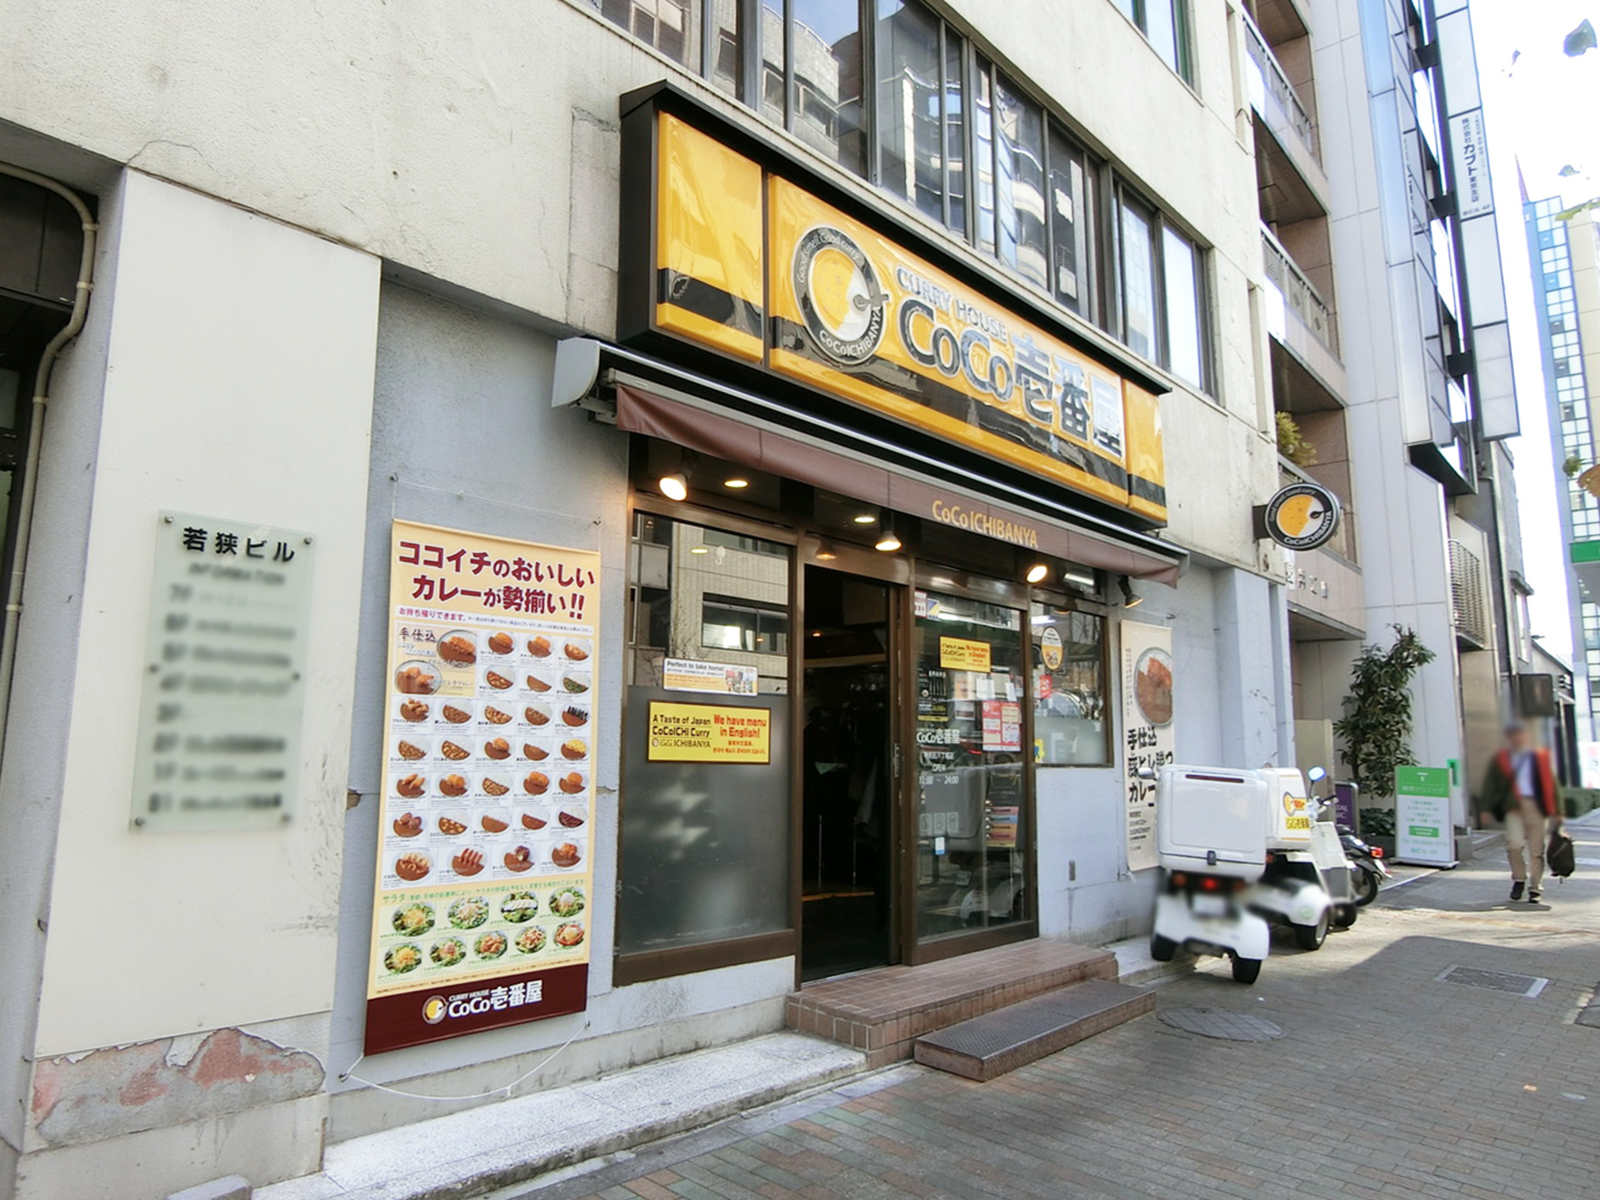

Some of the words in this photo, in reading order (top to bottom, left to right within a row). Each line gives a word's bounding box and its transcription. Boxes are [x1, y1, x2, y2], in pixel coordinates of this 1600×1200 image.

[896, 266, 951, 312] CURRY
[956, 302, 1008, 344] HOUSE
[899, 298, 1123, 459] CoCo壱番屋
[182, 526, 295, 563] 若狭ビル
[399, 541, 595, 588] ココイチのおいしい
[411, 575, 586, 620] カレーが勢揃い!!
[399, 607, 466, 622] お持ち帰りできます。
[399, 627, 437, 643] 手仕込
[666, 660, 687, 668] Perfect
[653, 714, 659, 722] A
[660, 714, 680, 724] Taste
[682, 716, 689, 724] of
[691, 717, 711, 725] Japan
[713, 714, 724, 725] We
[726, 715, 745, 726] have
[747, 718, 767, 727] menu
[652, 726, 689, 736] CoCoICHI
[691, 727, 710, 738] Curry
[720, 726, 727, 736] in
[729, 727, 760, 738] English!
[1127, 726, 1157, 750] 手仕込
[383, 892, 406, 903] サラダ
[448, 980, 543, 1018] CoCo壱番屋
